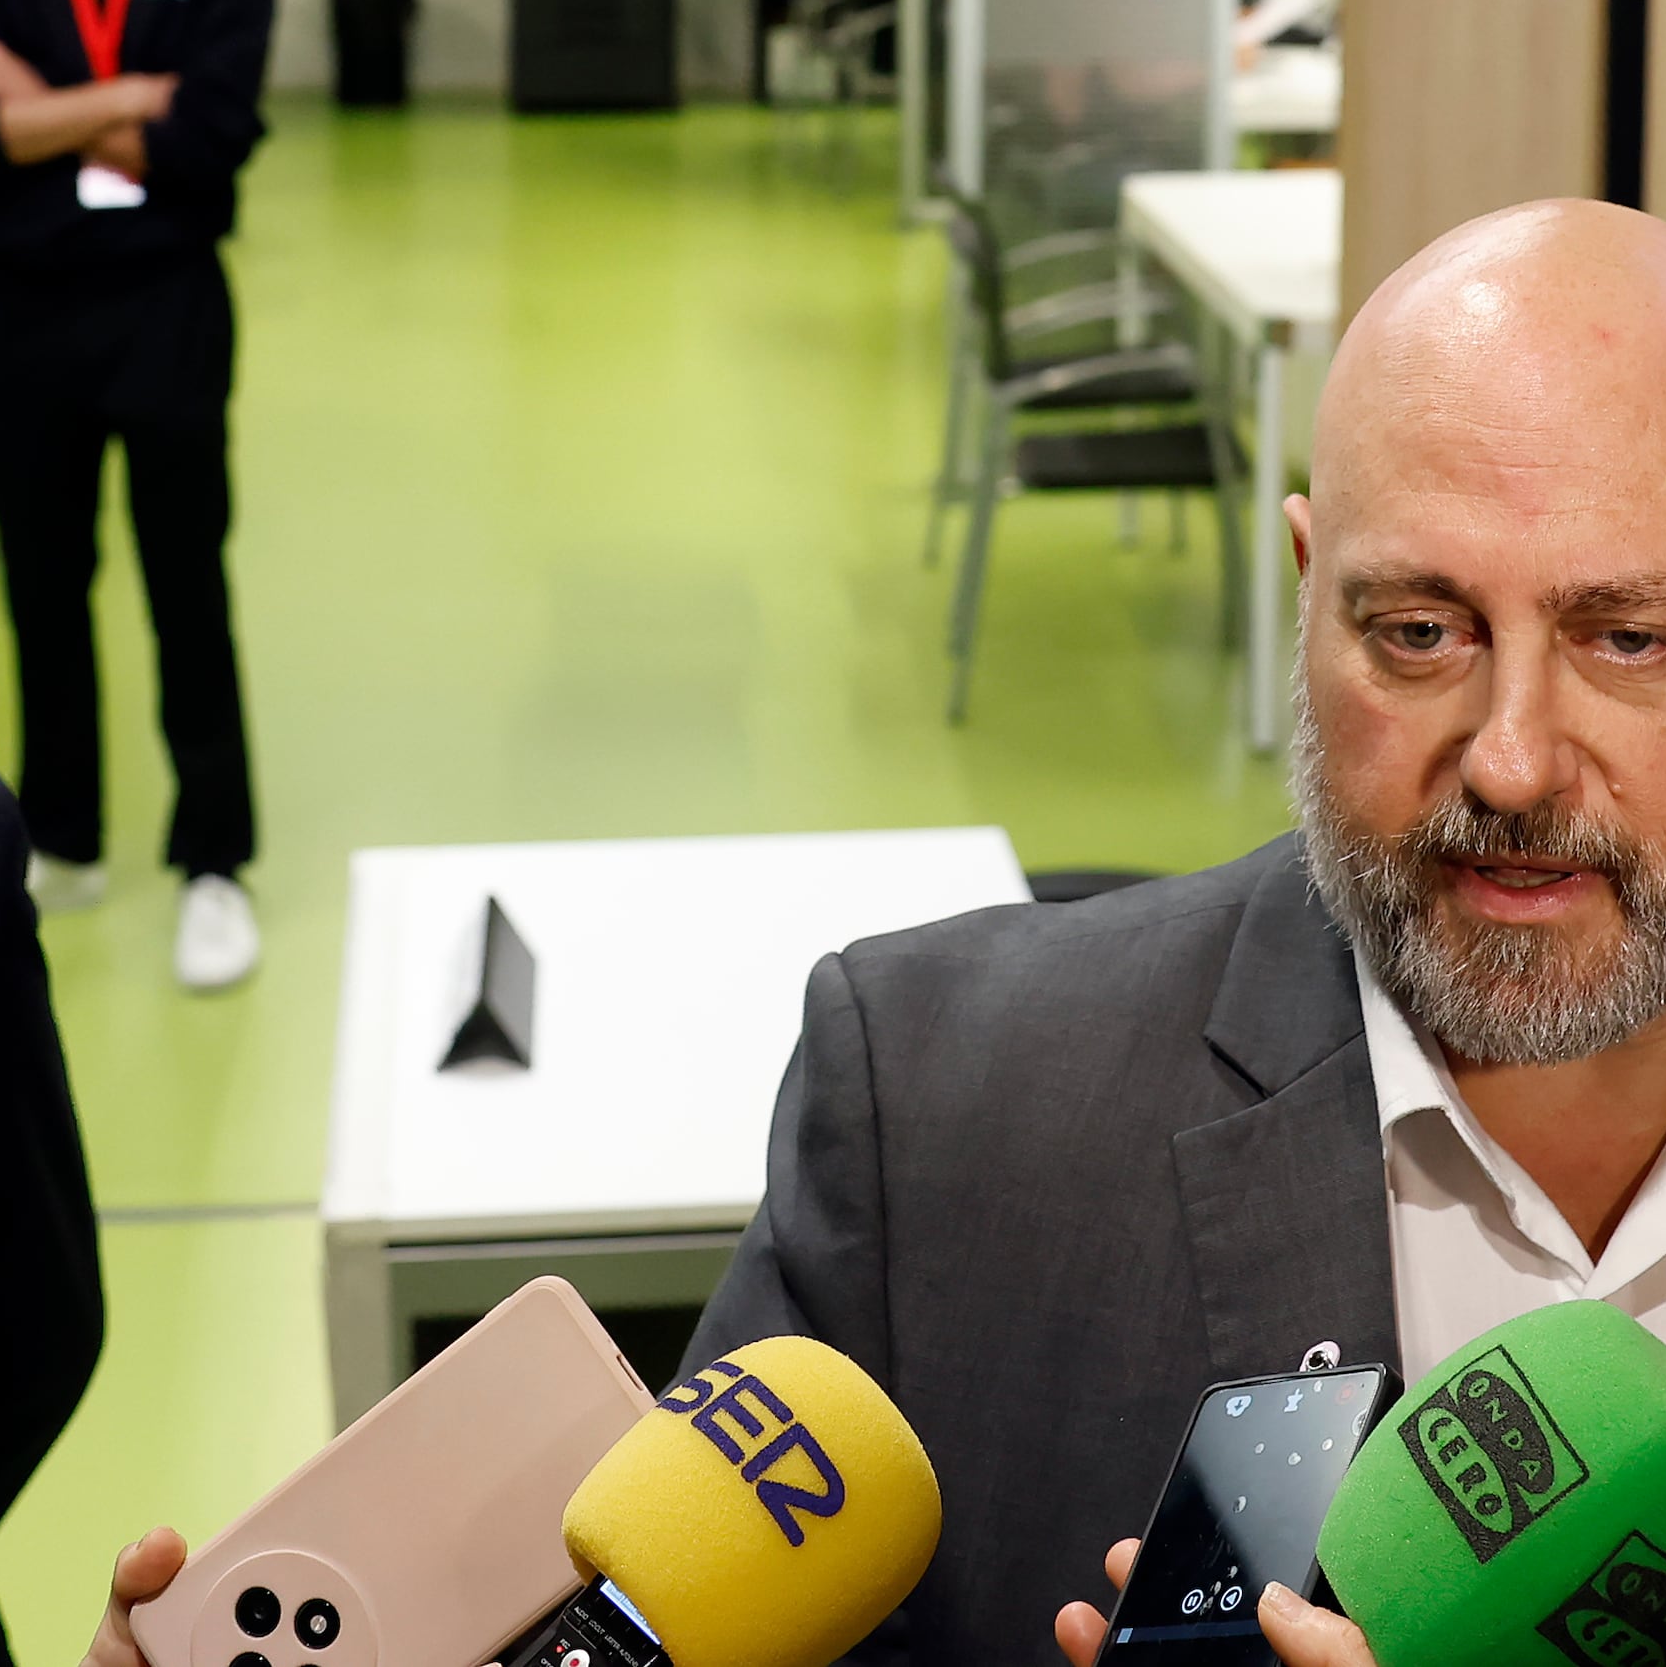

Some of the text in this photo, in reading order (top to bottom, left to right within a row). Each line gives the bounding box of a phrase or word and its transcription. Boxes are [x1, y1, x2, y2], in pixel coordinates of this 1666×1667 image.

[655, 1361, 845, 1547] SER
[1428, 1417, 1503, 1516] CERO
[1466, 1377, 1541, 1480] ONDA
